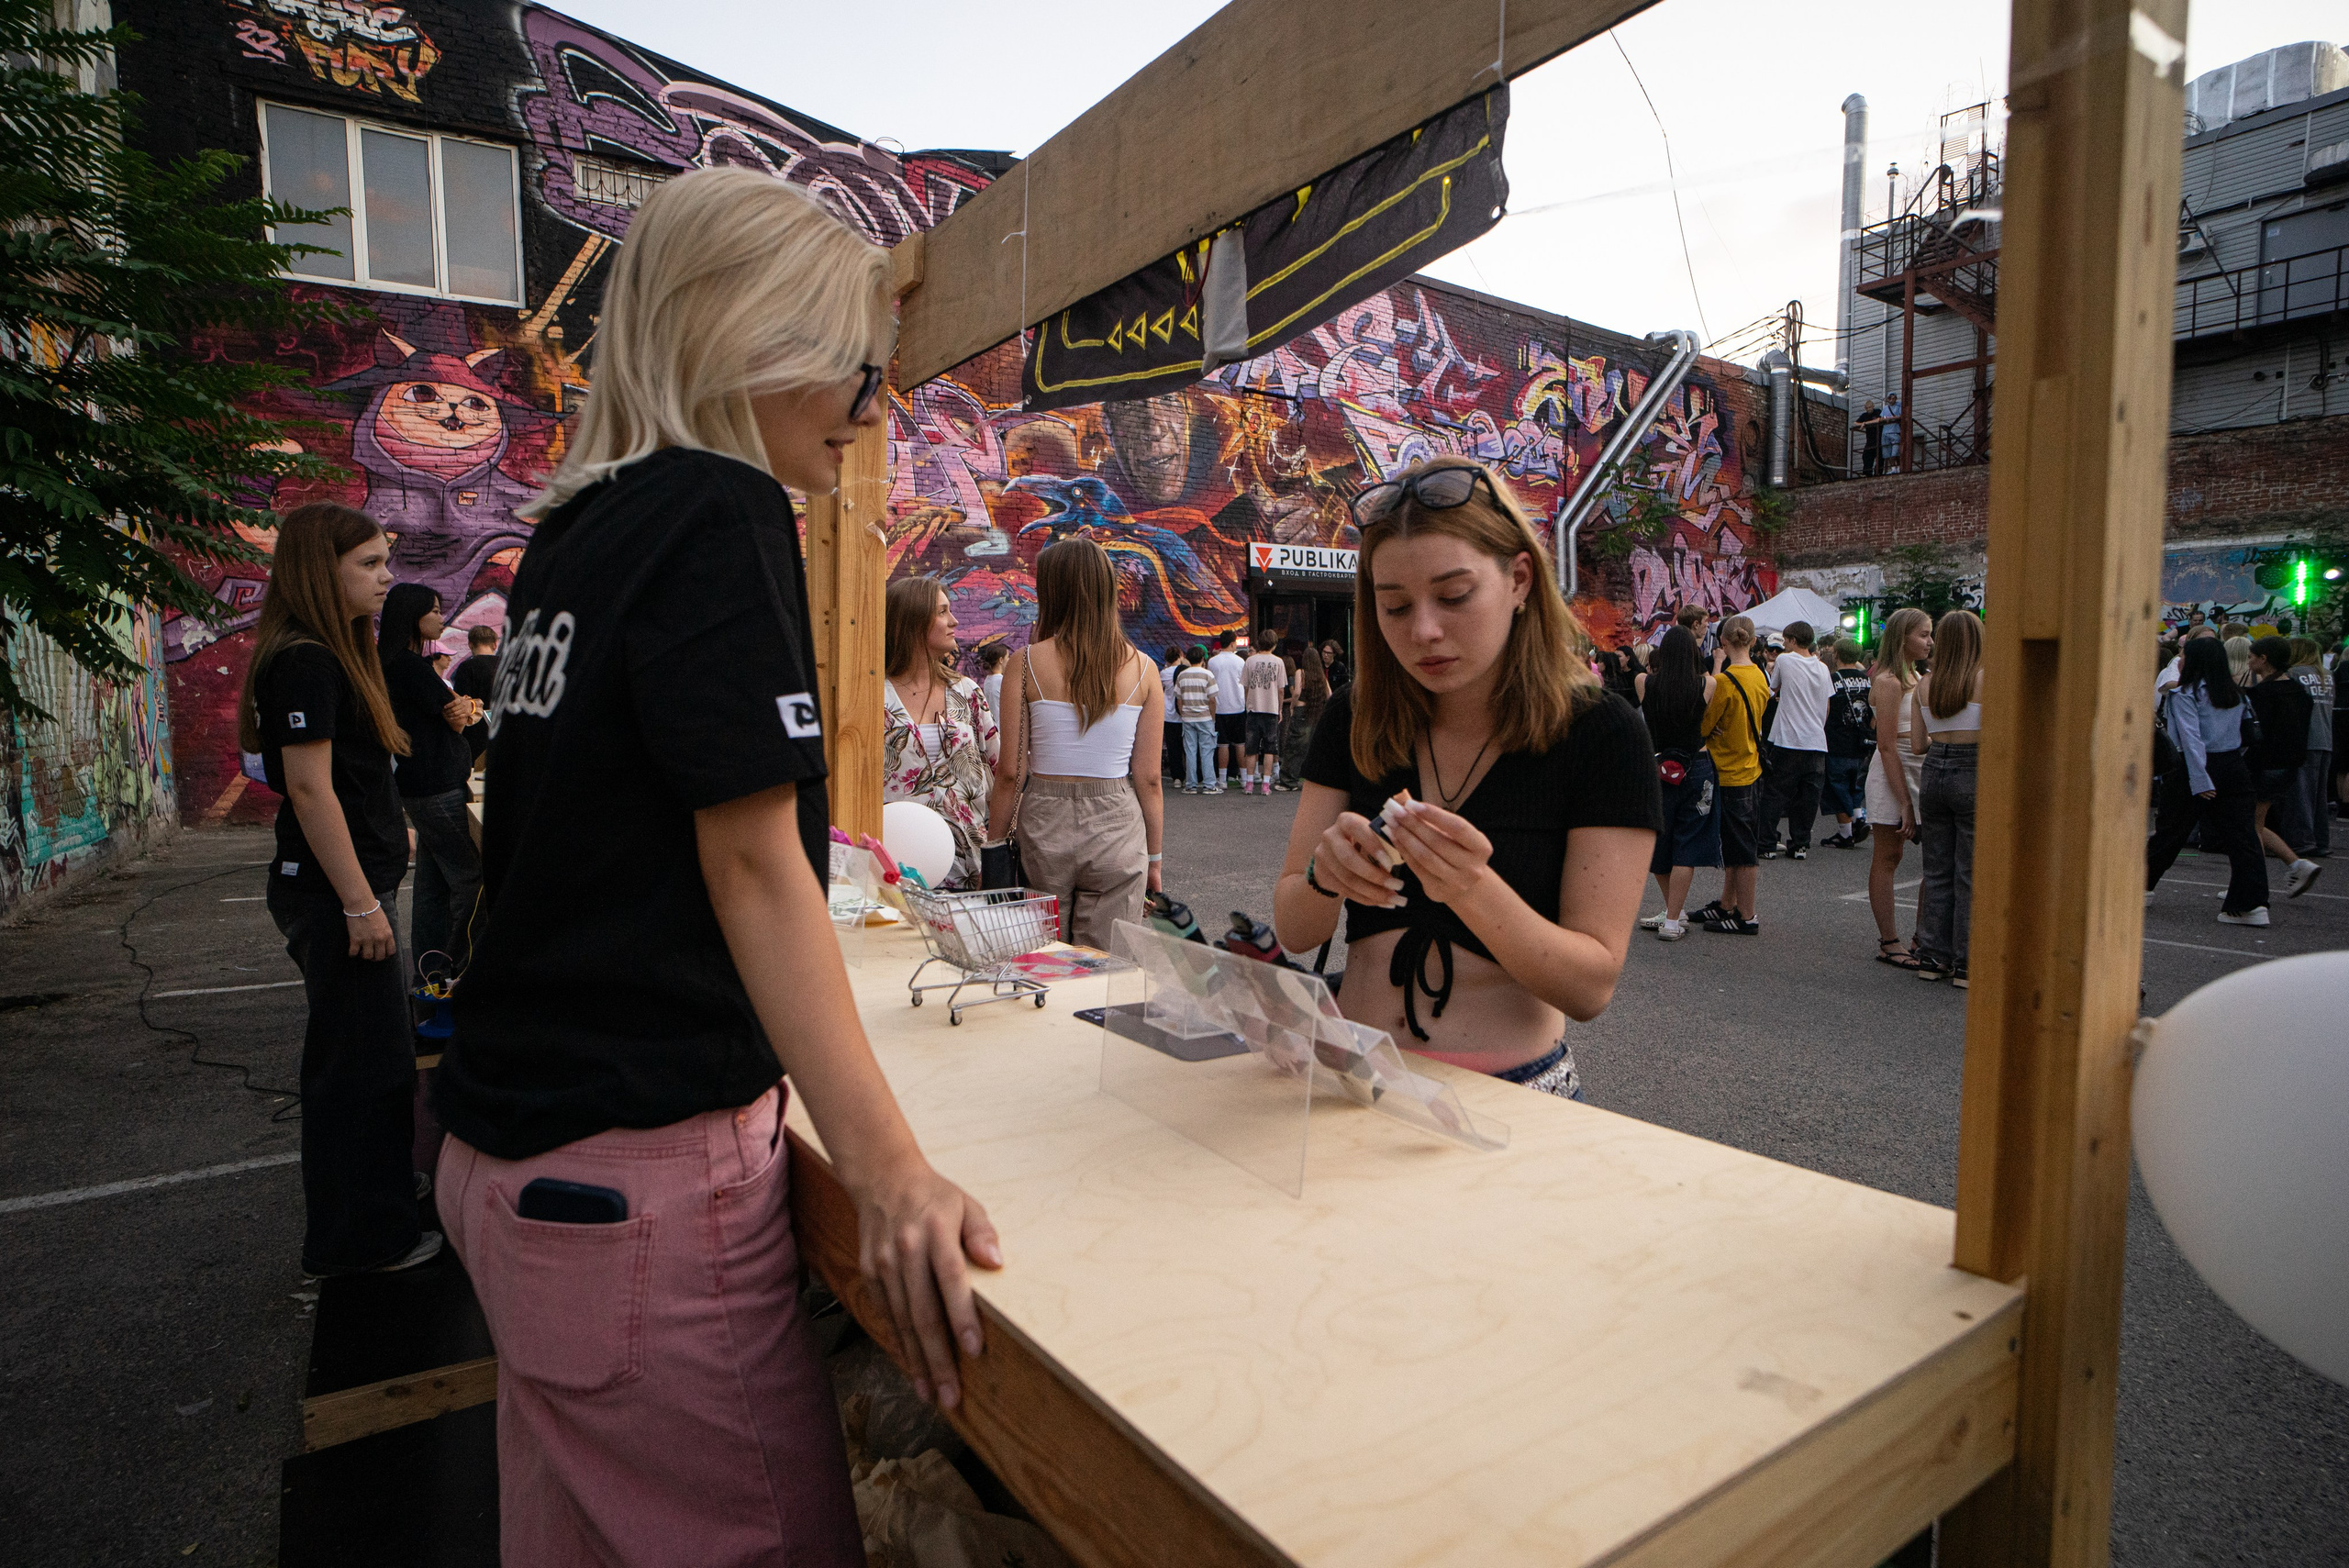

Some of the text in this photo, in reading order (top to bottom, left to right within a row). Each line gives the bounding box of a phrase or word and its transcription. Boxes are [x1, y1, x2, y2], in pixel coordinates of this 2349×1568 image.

[1280, 548, 1358, 570] PUBLIKA
[1281, 569, 1299, 577] ВХОД
[1308, 571, 1357, 579] ГАСТРОКВАРТА
